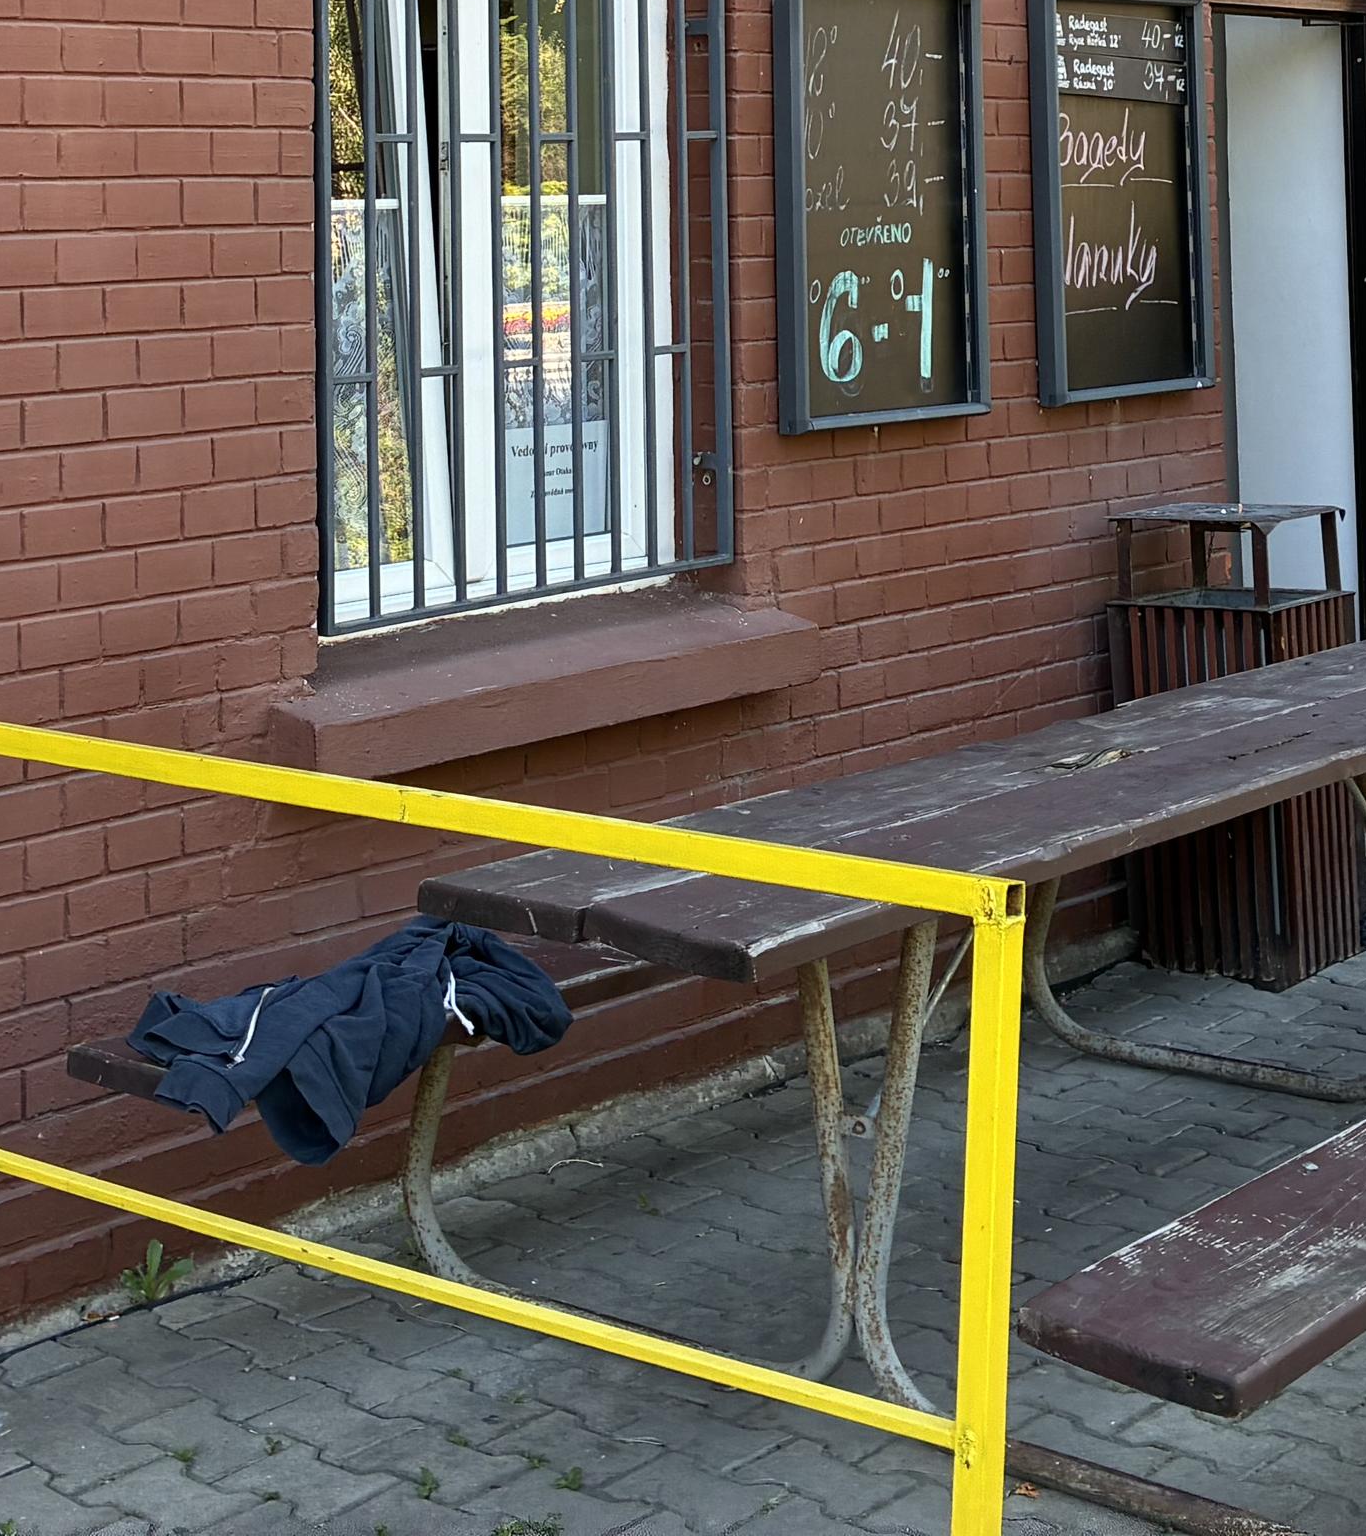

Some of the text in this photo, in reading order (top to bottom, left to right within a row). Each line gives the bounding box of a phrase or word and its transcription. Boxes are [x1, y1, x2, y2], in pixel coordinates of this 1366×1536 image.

[1068, 14, 1108, 37] Radegast
[1073, 58, 1115, 81] Radegast
[805, 165, 850, 211] ozel
[840, 216, 912, 247] OTEVŘENO
